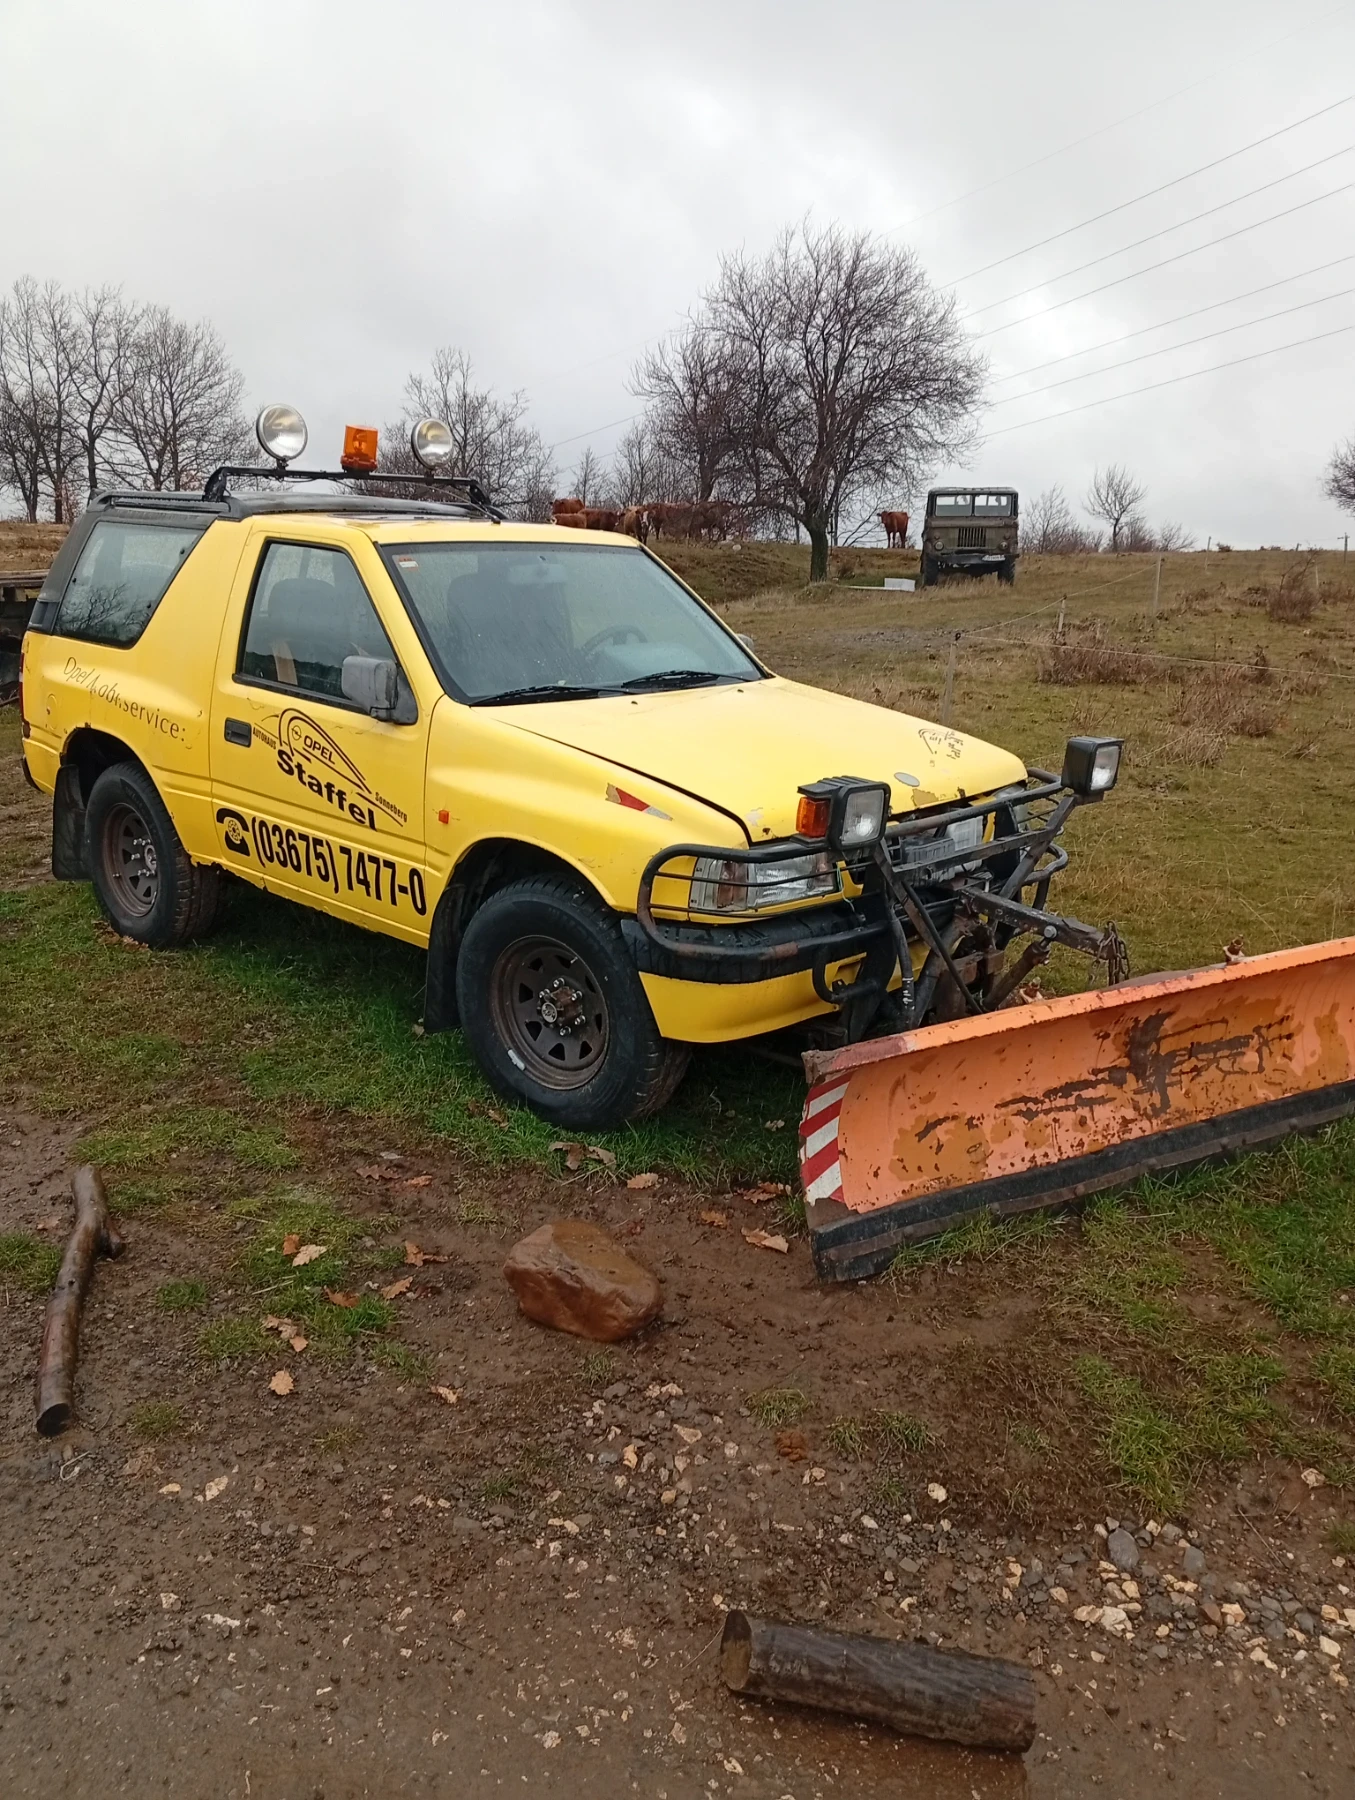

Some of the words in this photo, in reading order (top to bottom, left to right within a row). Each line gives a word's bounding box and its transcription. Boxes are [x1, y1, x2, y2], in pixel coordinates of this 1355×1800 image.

[63, 656, 95, 684] Opel
[253, 726, 277, 750] AUTOHAUS
[303, 735, 336, 765] OPEL
[277, 749, 377, 832] Staffel
[375, 791, 408, 823] Sonneberg
[252, 816, 340, 894] (03675)
[339, 845, 427, 916] 7477-0
